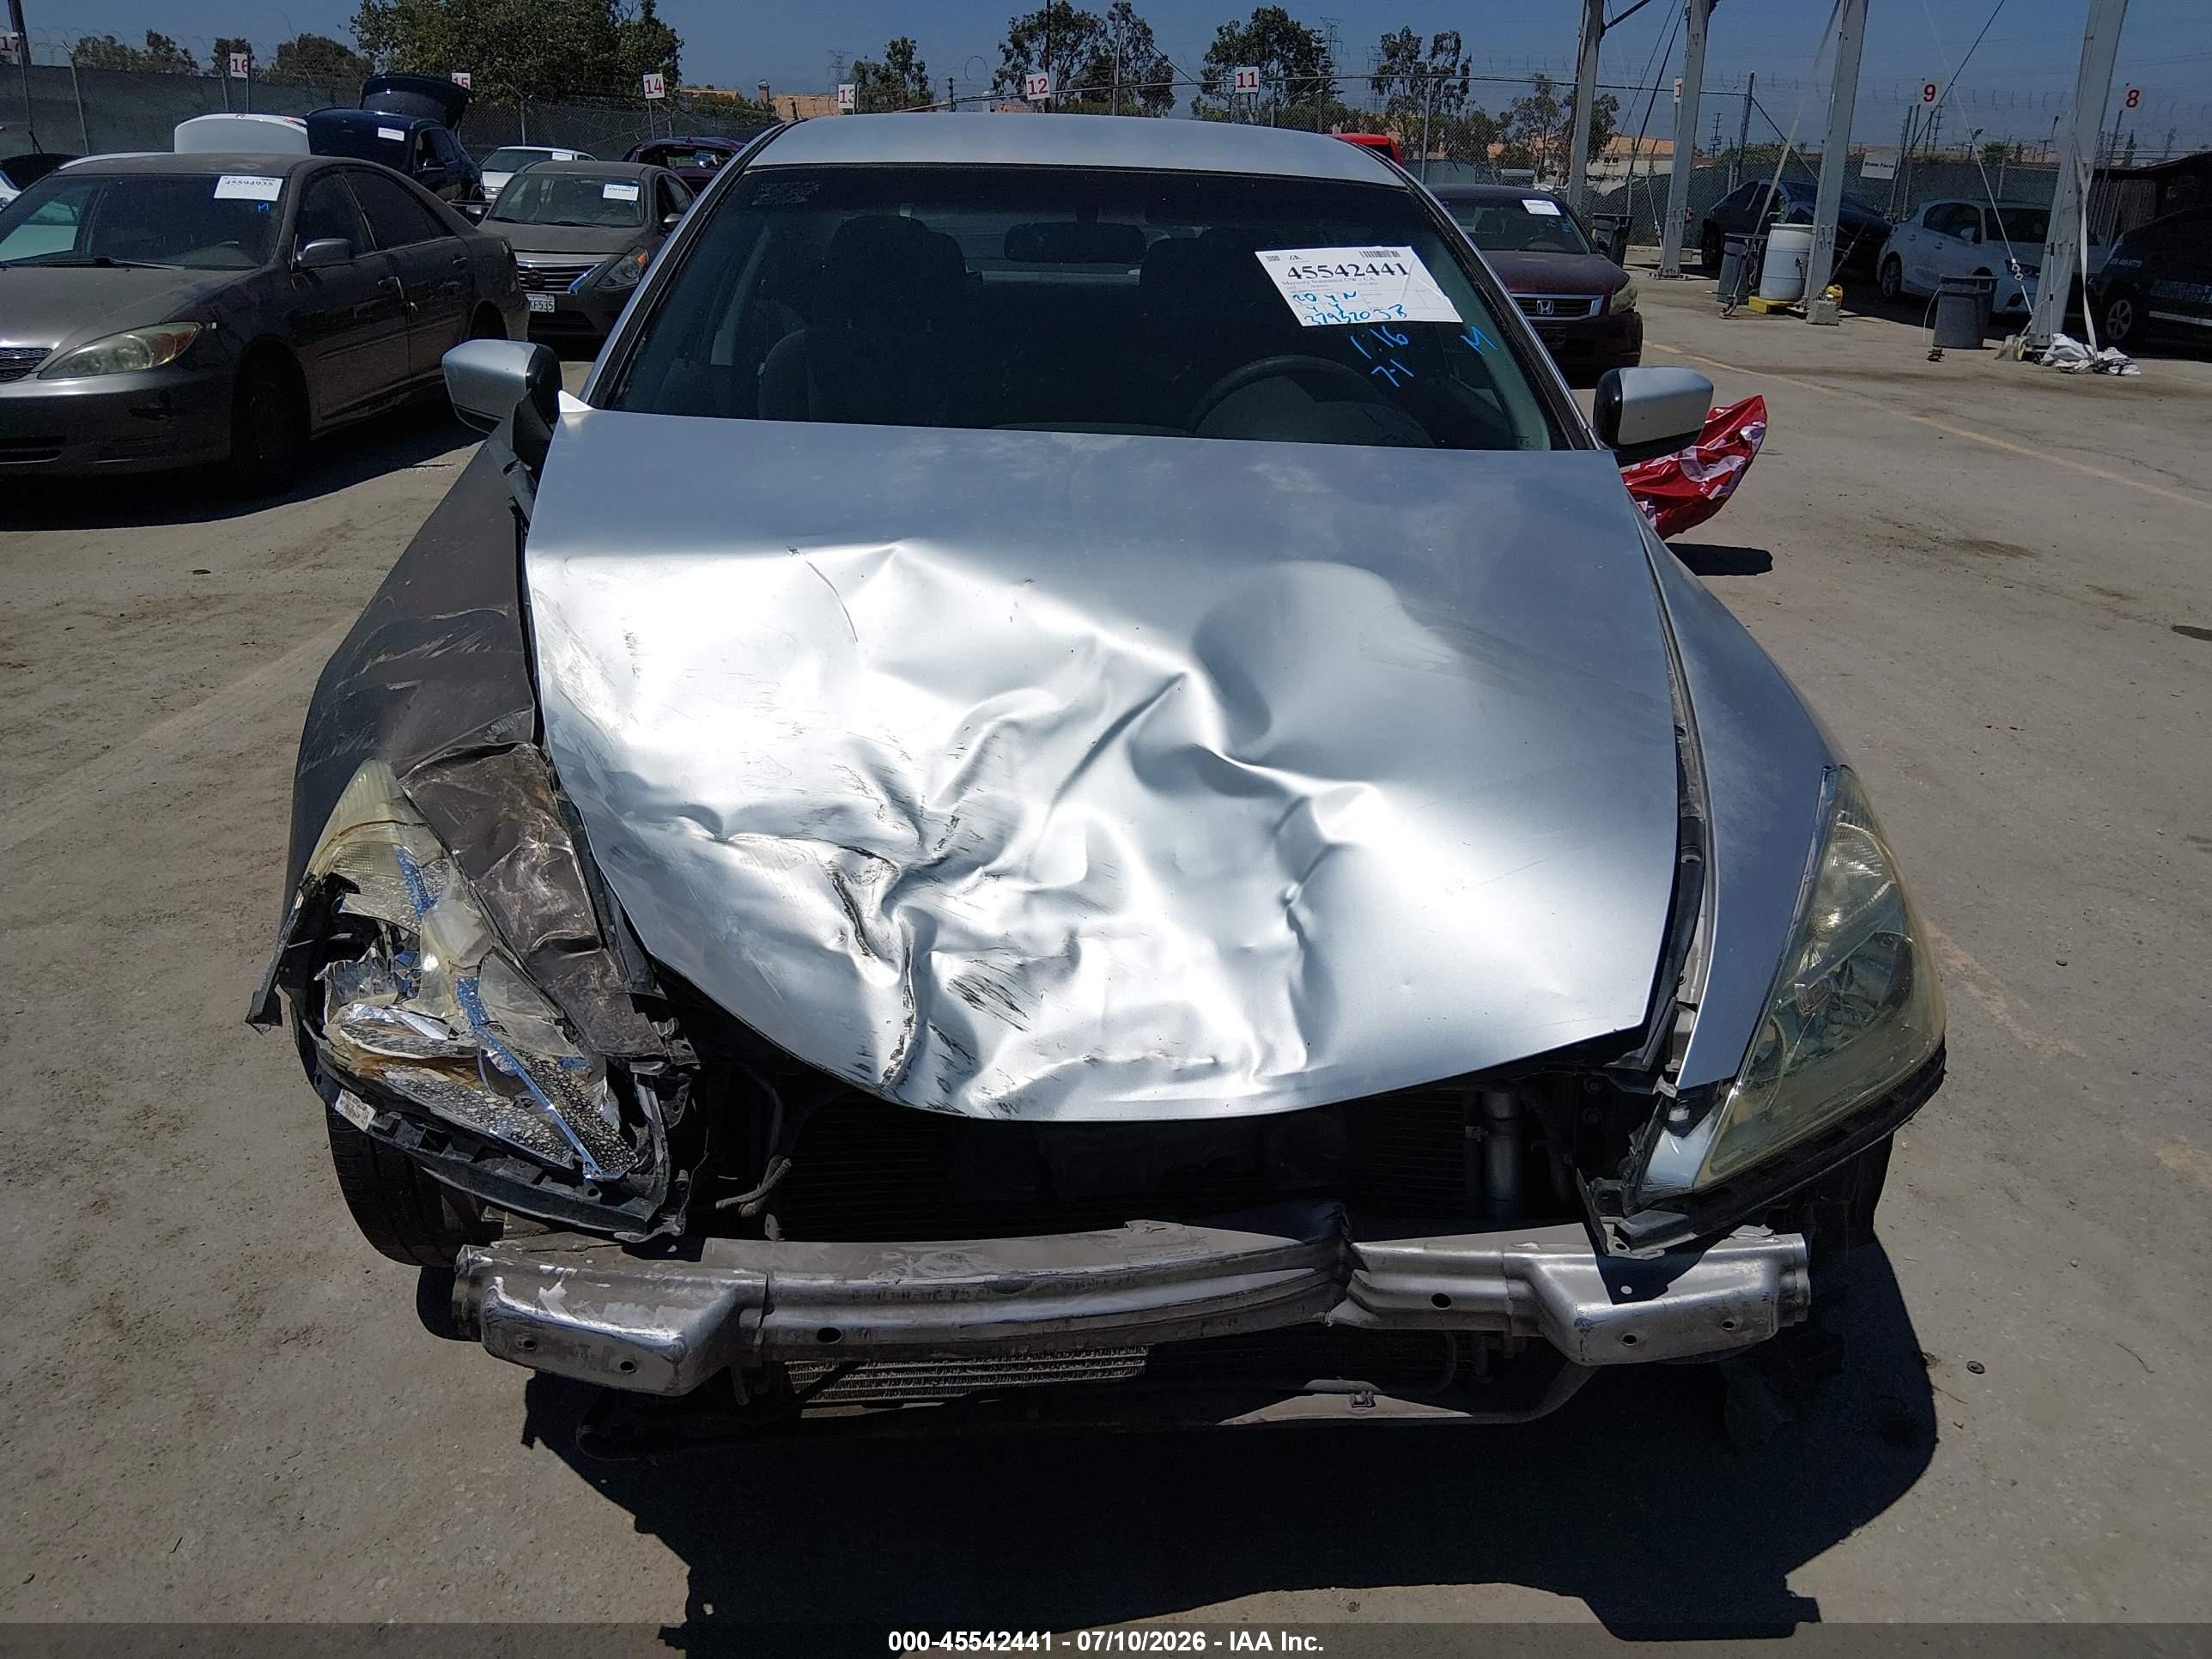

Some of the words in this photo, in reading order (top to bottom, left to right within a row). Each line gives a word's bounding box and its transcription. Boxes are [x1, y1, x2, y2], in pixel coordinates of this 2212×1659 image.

[232, 58, 247, 73] 16
[645, 78, 663, 94] 14
[1027, 78, 1048, 95] 12
[1237, 71, 1257, 88] 11
[839, 89, 854, 103] 13
[1923, 84, 1936, 102] 9
[2125, 89, 2140, 108] 8
[1287, 262, 1408, 279] 45542441
